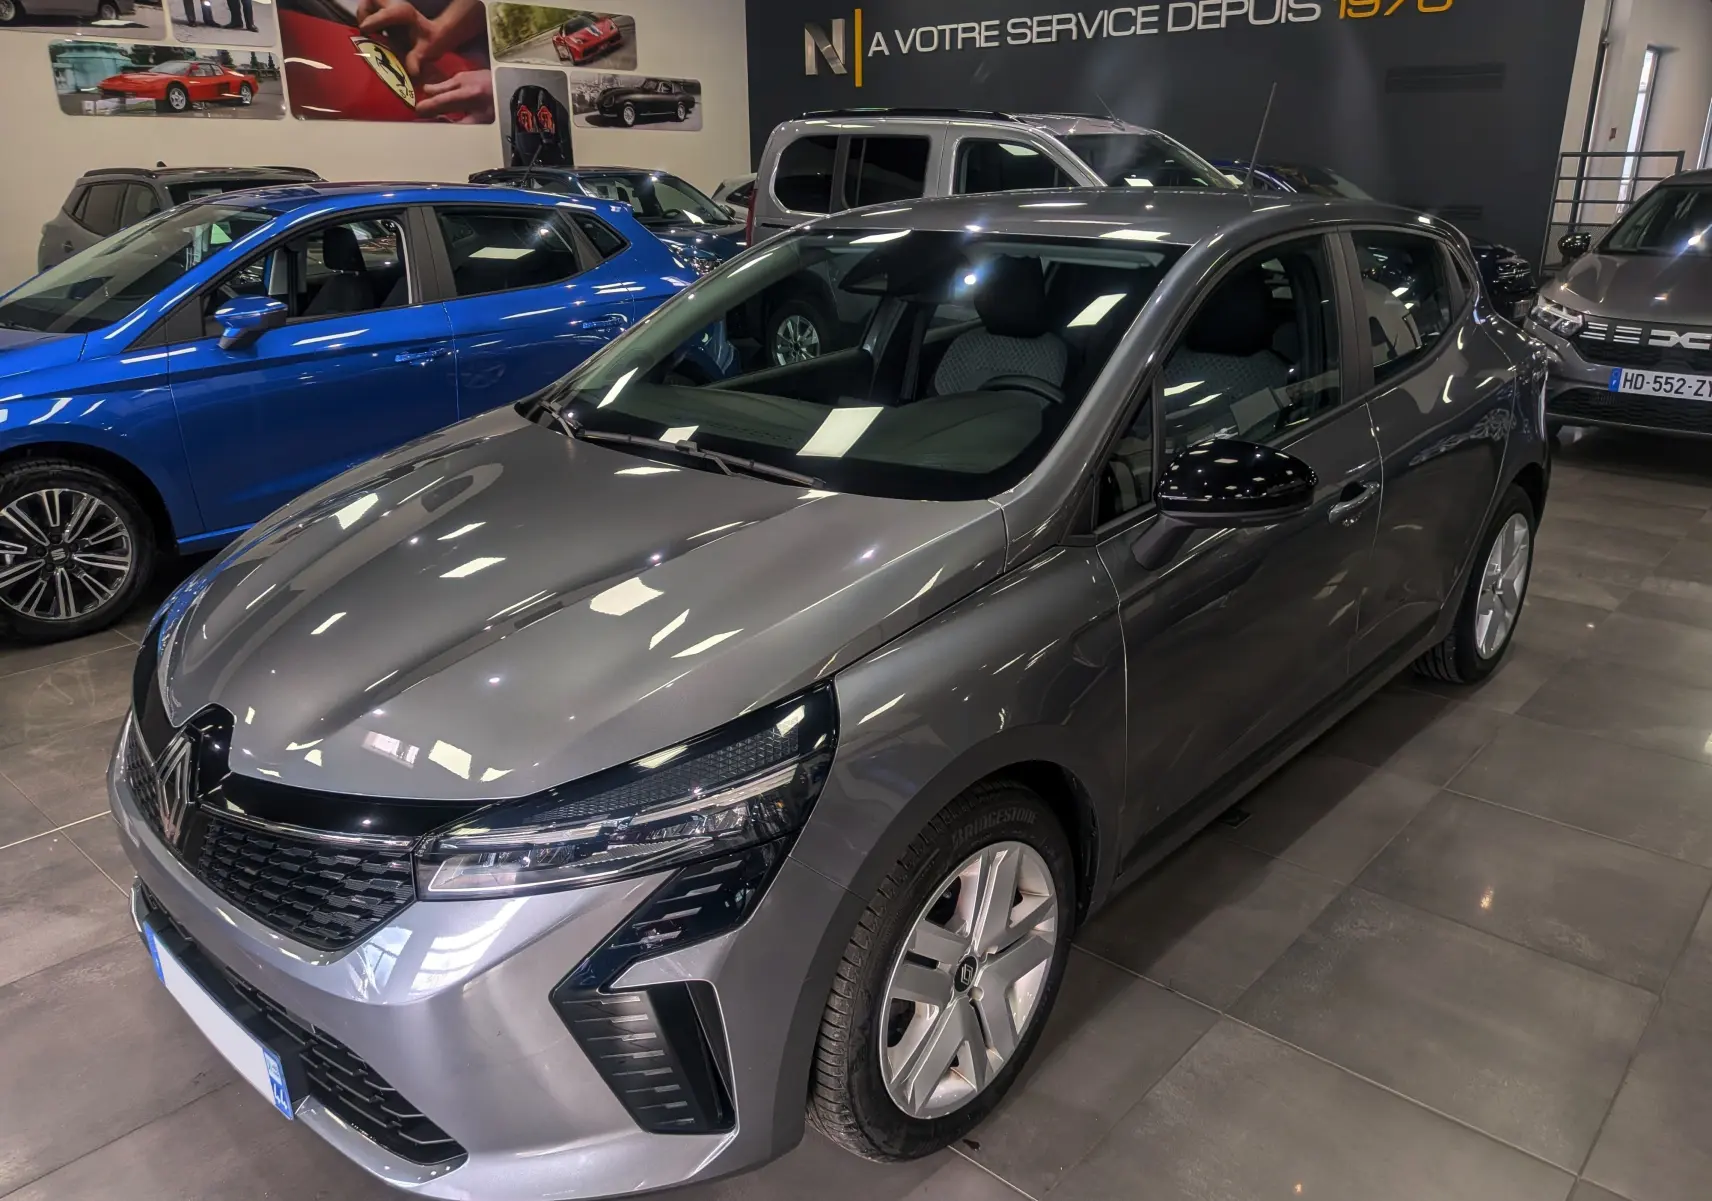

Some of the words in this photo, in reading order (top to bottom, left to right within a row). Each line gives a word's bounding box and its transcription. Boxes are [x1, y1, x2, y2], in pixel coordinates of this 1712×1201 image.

[894, 20, 1000, 54] VOTRE
[1006, 4, 1160, 45] SERVICE
[1167, 0, 1321, 32] DEPUIS
